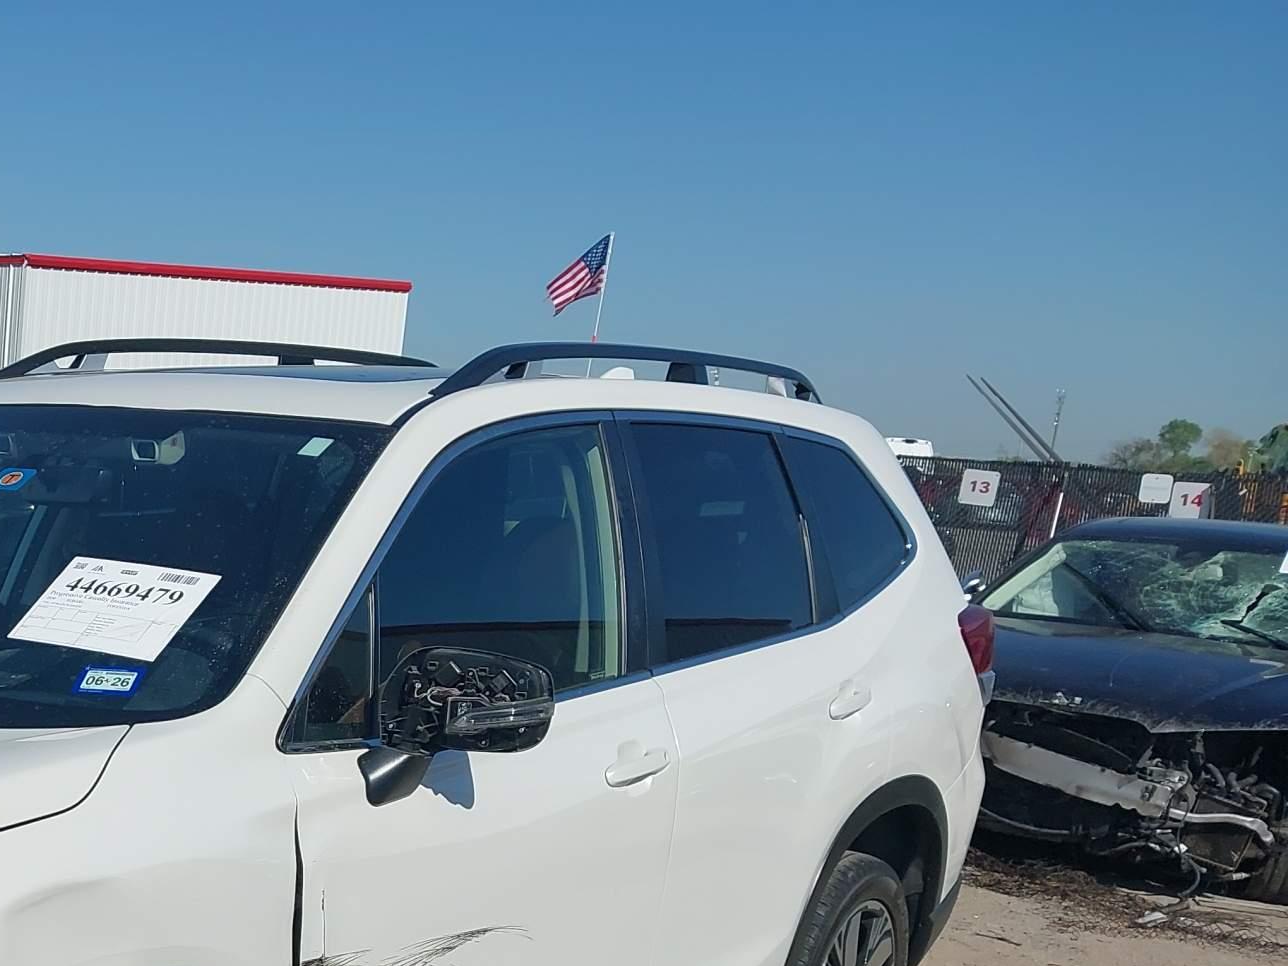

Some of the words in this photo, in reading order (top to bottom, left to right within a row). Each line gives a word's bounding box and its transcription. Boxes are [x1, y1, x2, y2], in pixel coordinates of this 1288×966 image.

[969, 480, 991, 494] 13
[1180, 493, 1203, 507] 14
[65, 576, 185, 605] 44669479
[86, 676, 104, 686] 06
[111, 677, 131, 687] 26
